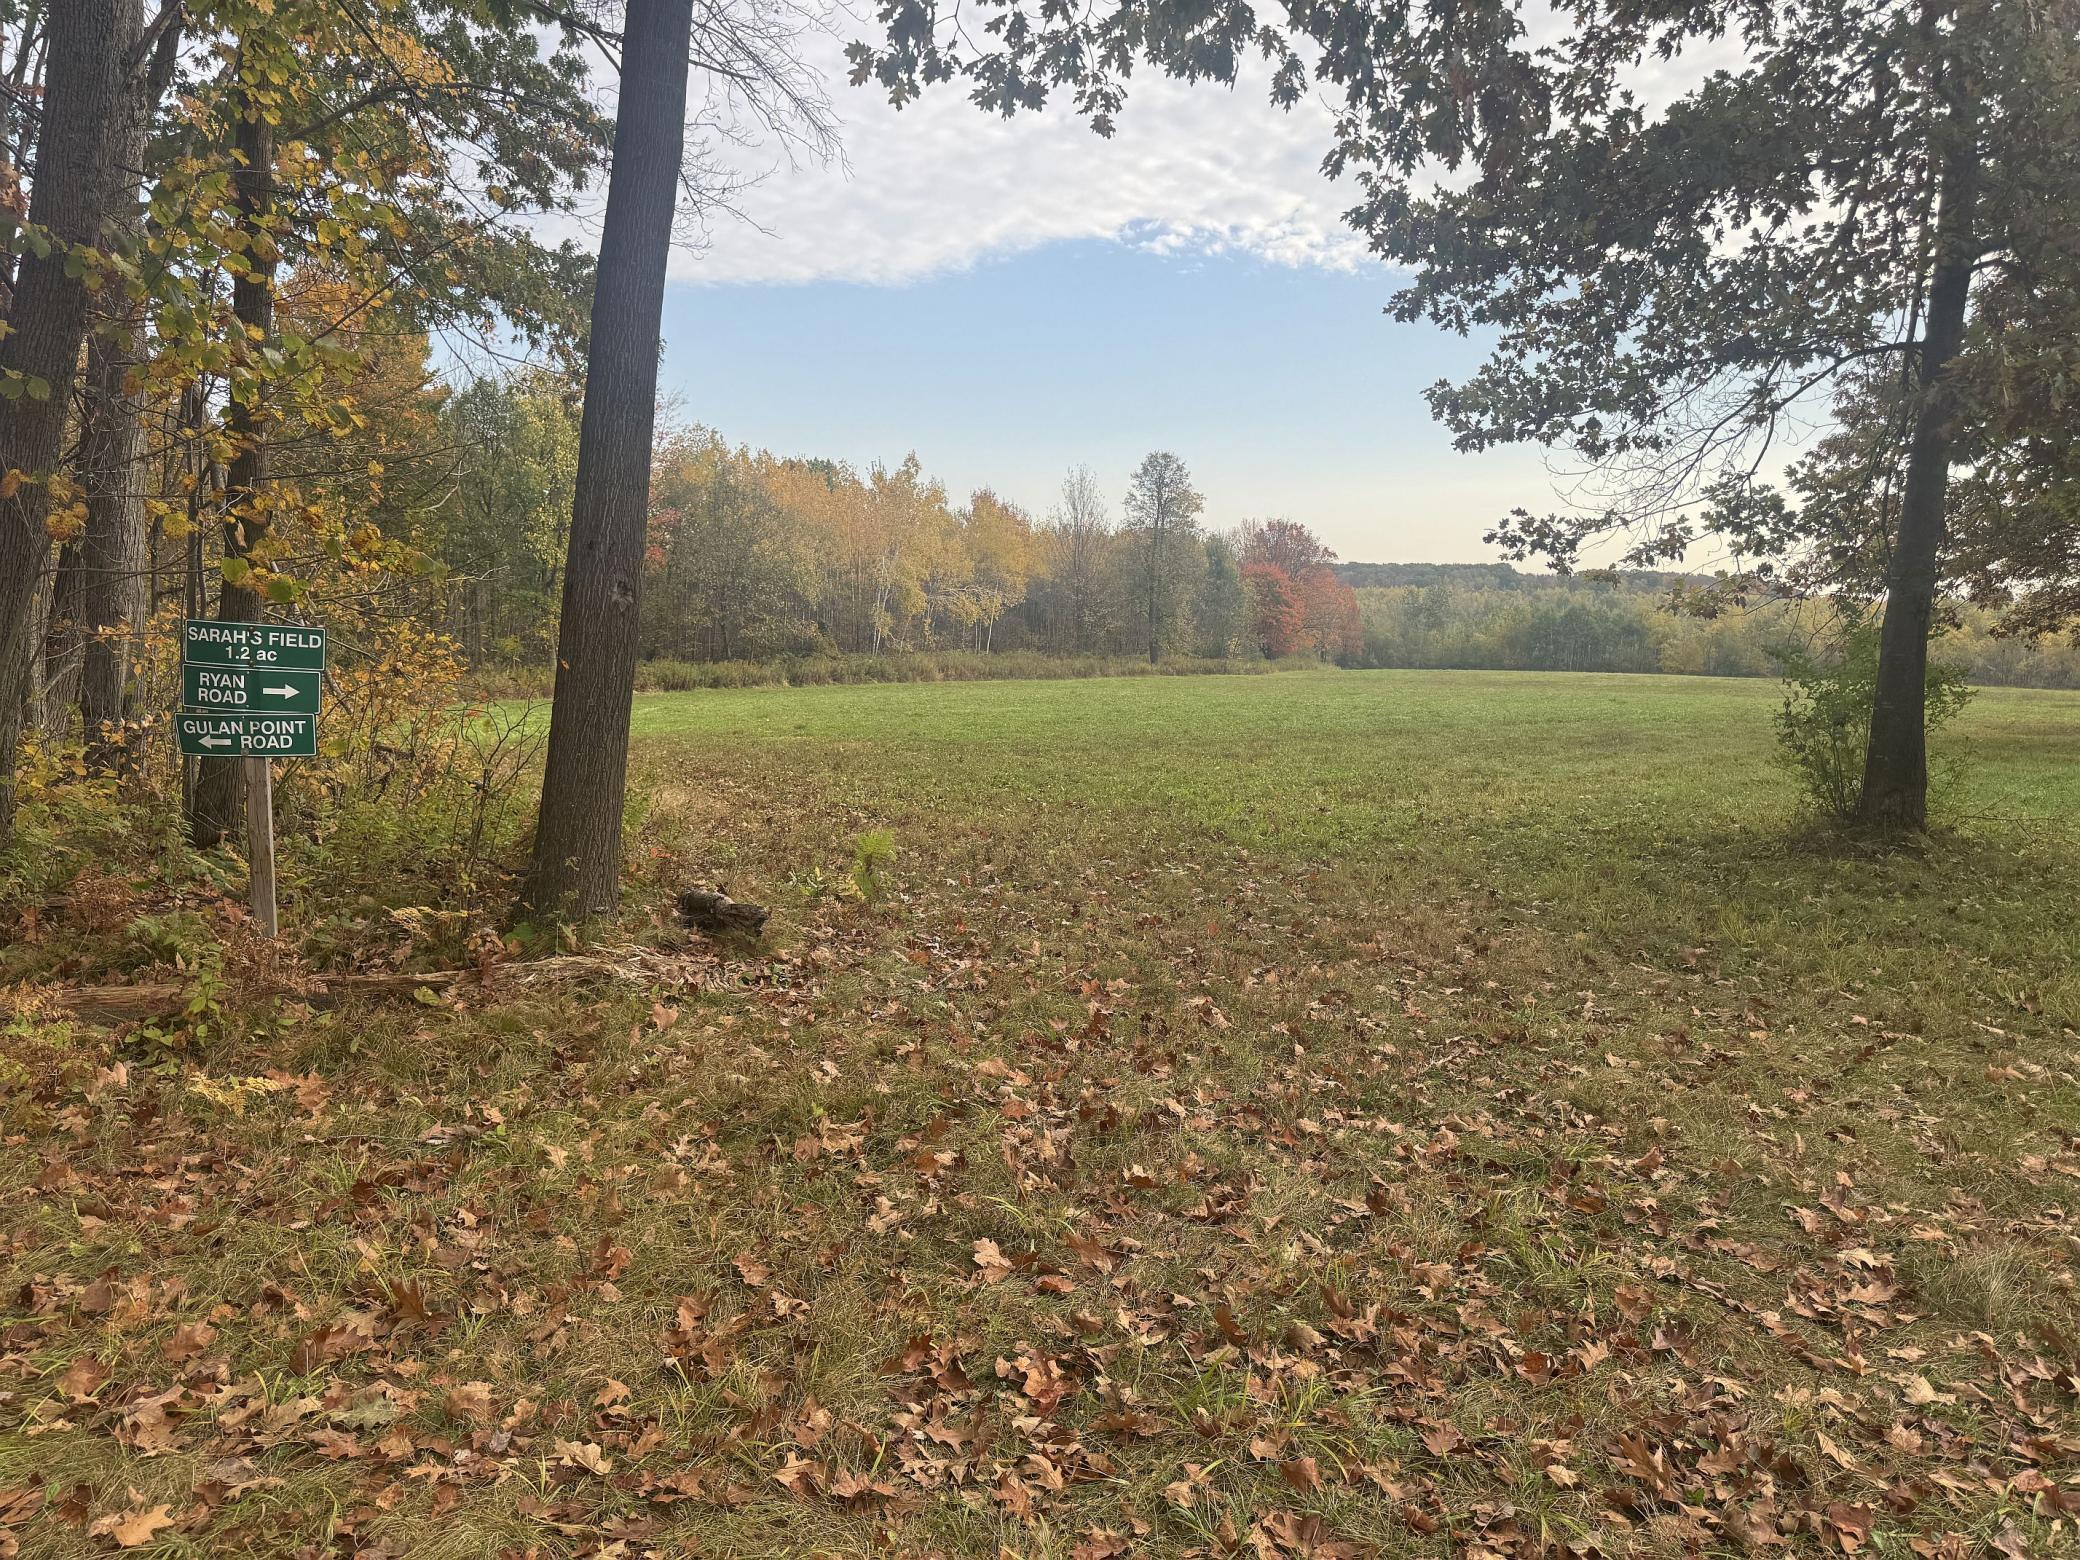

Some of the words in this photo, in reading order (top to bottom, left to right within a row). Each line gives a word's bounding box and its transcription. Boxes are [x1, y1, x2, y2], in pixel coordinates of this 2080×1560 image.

[188, 626, 263, 645] SARAH'S
[268, 632, 322, 649] FIELD
[225, 645, 250, 660] 1.2
[256, 649, 278, 661] ac
[199, 672, 245, 689] RYAN
[198, 687, 247, 704] ROAD
[183, 720, 243, 735] GULAN
[250, 720, 306, 735] POINT
[240, 735, 293, 749] ROAD
